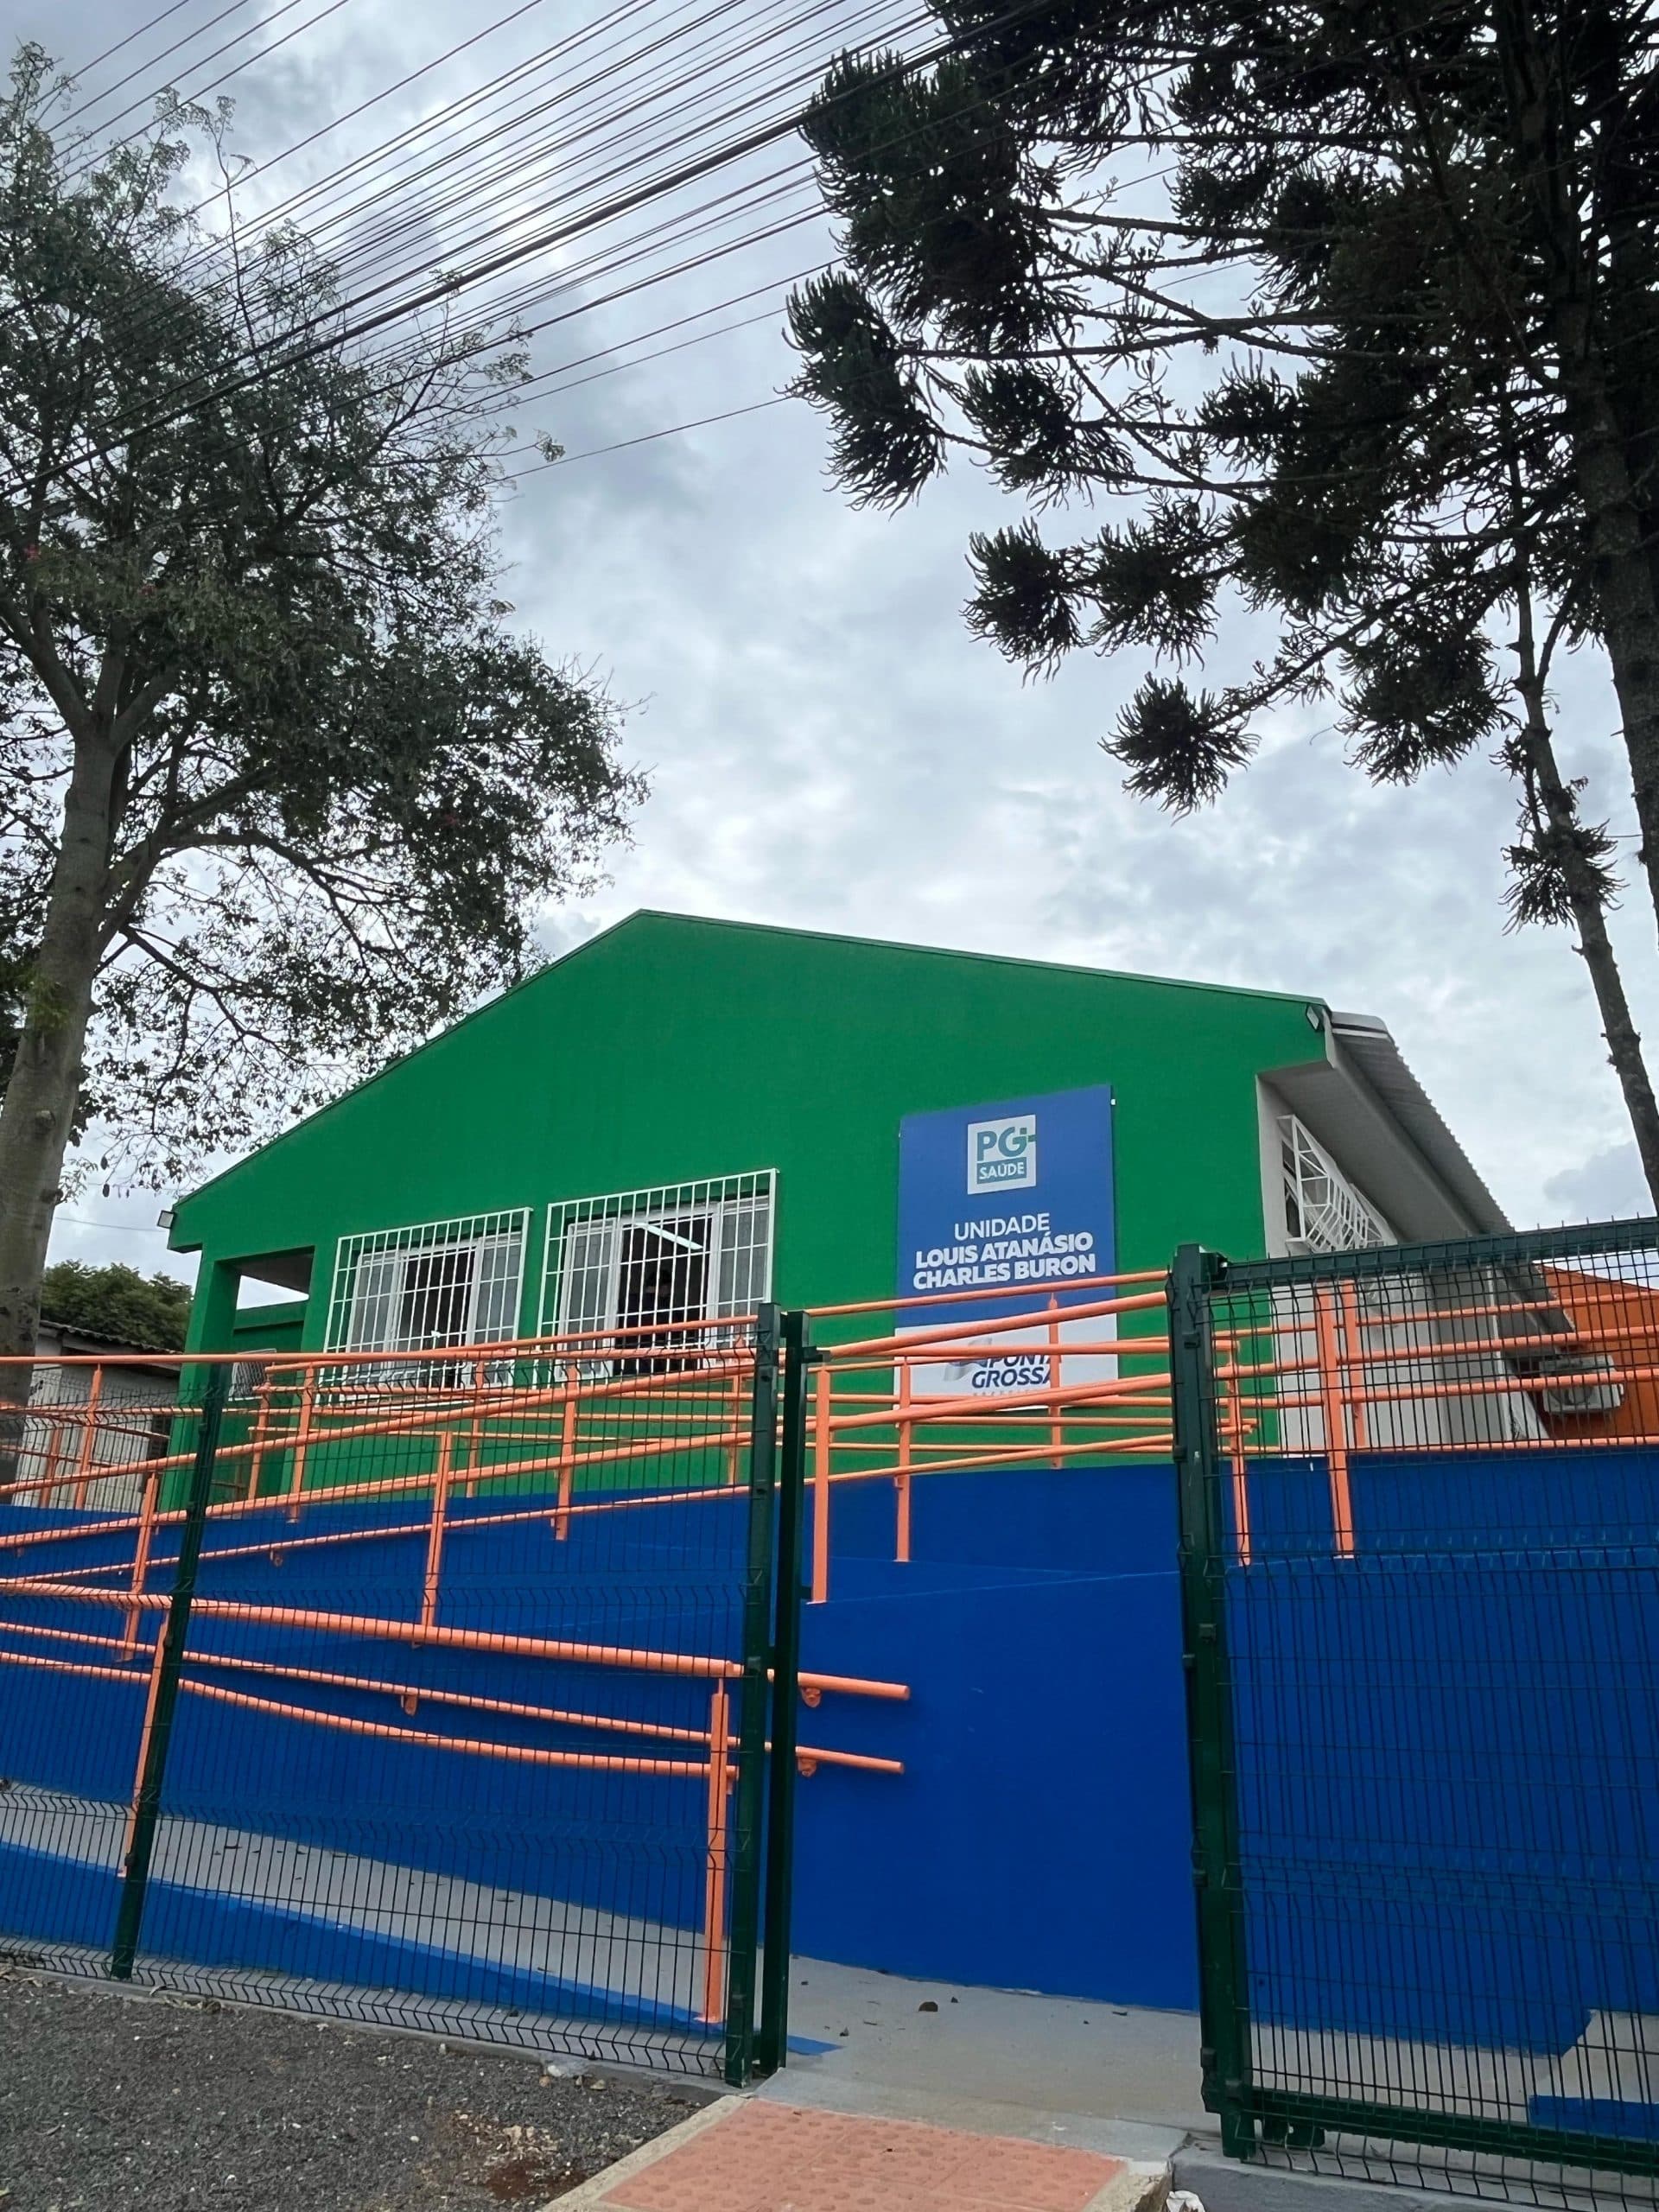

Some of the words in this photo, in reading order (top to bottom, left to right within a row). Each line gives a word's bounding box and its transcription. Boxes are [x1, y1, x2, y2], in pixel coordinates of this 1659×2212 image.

[954, 1213, 1050, 1241] UNIDADE
[916, 1245, 978, 1268] LOUIS
[981, 1231, 1094, 1262] ATANÁSIO
[913, 1262, 1011, 1290] CHARLES
[1014, 1254, 1096, 1280] BURON
